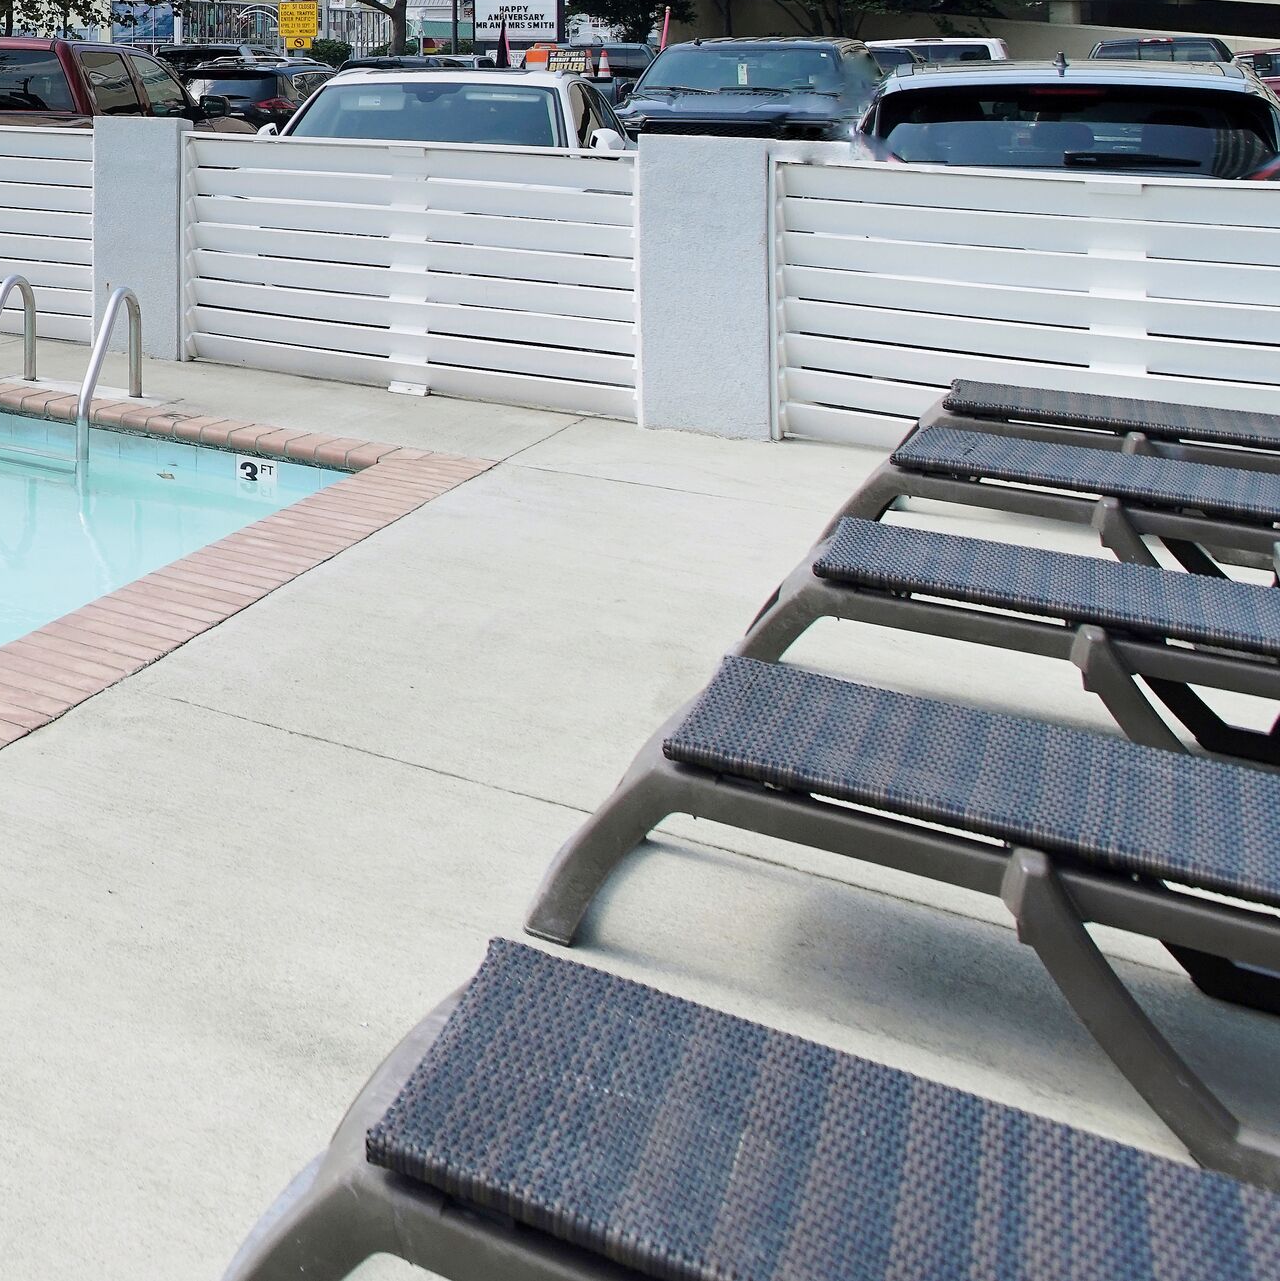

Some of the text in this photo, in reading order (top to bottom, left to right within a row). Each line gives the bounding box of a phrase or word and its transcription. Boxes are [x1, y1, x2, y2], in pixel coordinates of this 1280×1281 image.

[527, 21, 555, 29] SMITH
[549, 62, 586, 72] BUTLER
[240, 461, 274, 481] 3 FT
